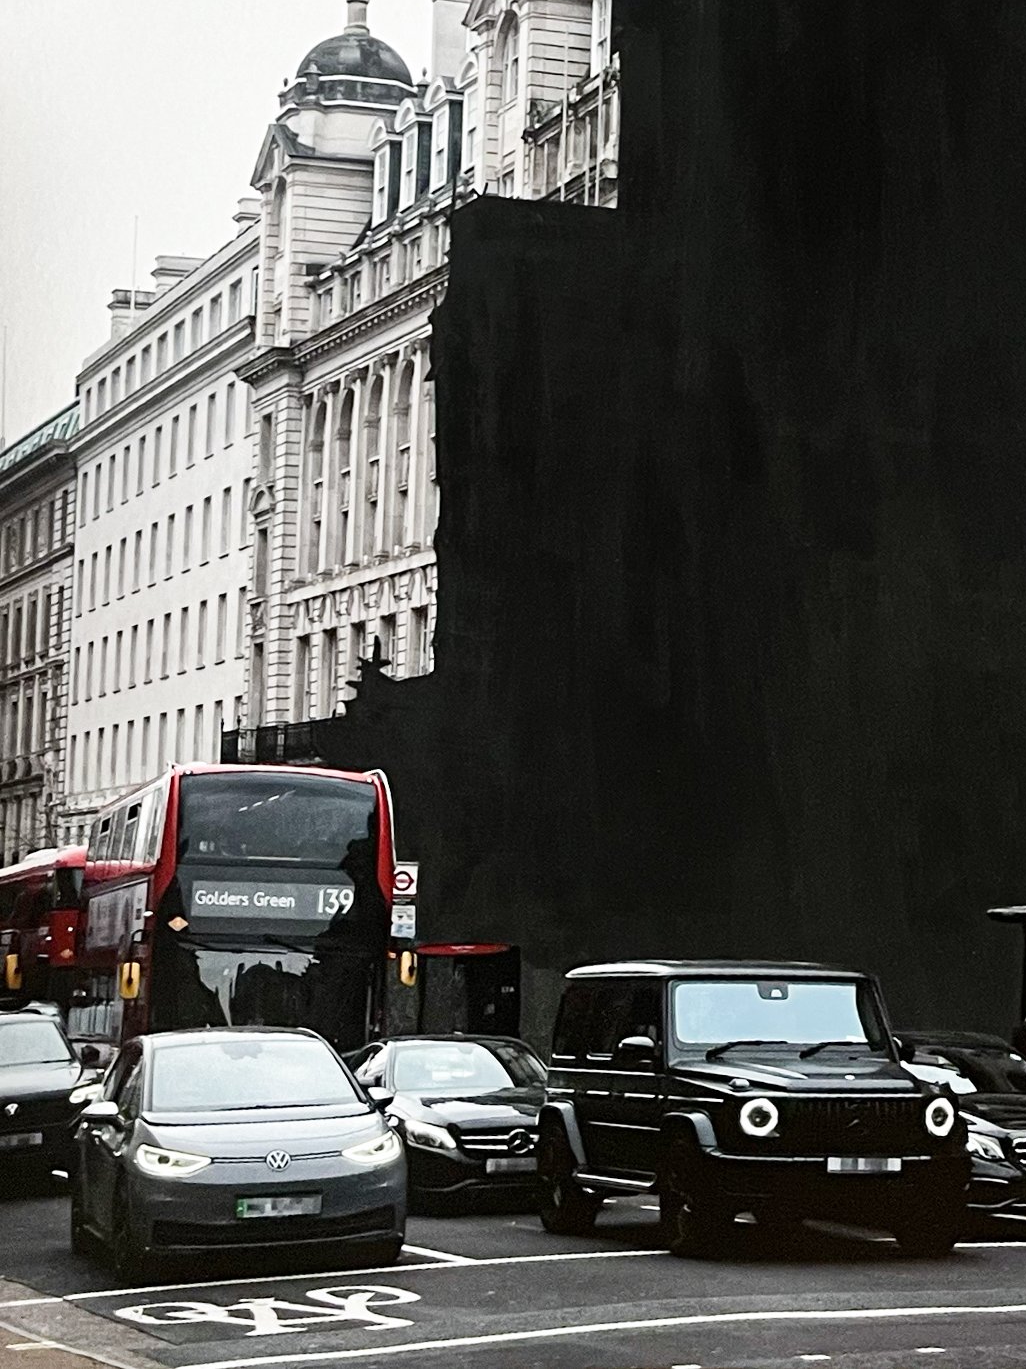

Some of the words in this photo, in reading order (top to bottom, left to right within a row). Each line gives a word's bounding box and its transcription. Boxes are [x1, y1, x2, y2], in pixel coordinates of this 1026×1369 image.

[194, 889, 249, 906] Golders
[253, 892, 296, 908] Green
[317, 888, 354, 915] 139
